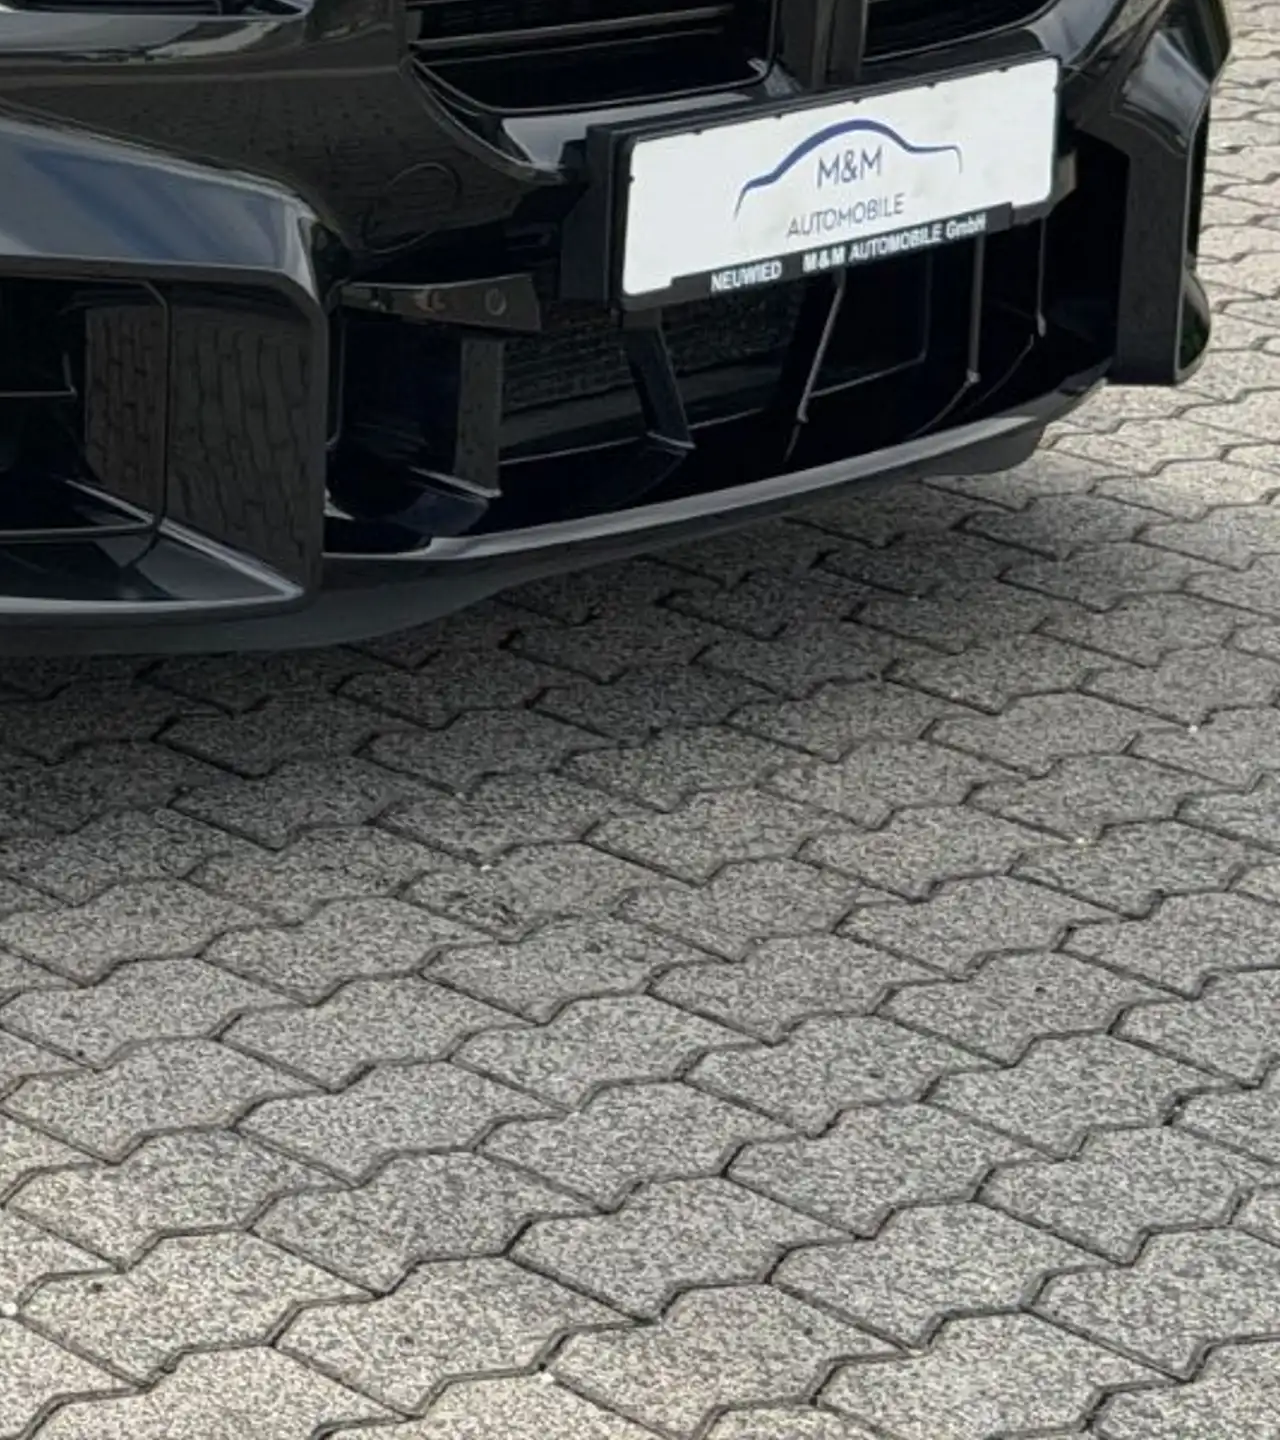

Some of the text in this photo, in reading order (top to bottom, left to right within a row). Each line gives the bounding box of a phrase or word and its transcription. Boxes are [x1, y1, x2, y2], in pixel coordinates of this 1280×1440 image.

[817, 144, 883, 189] M&M
[786, 192, 905, 238] AUTOMOBILE
[710, 261, 783, 293] NEUWIED
[848, 223, 942, 262] AUTOMOBILE
[945, 211, 985, 242] GmbH
